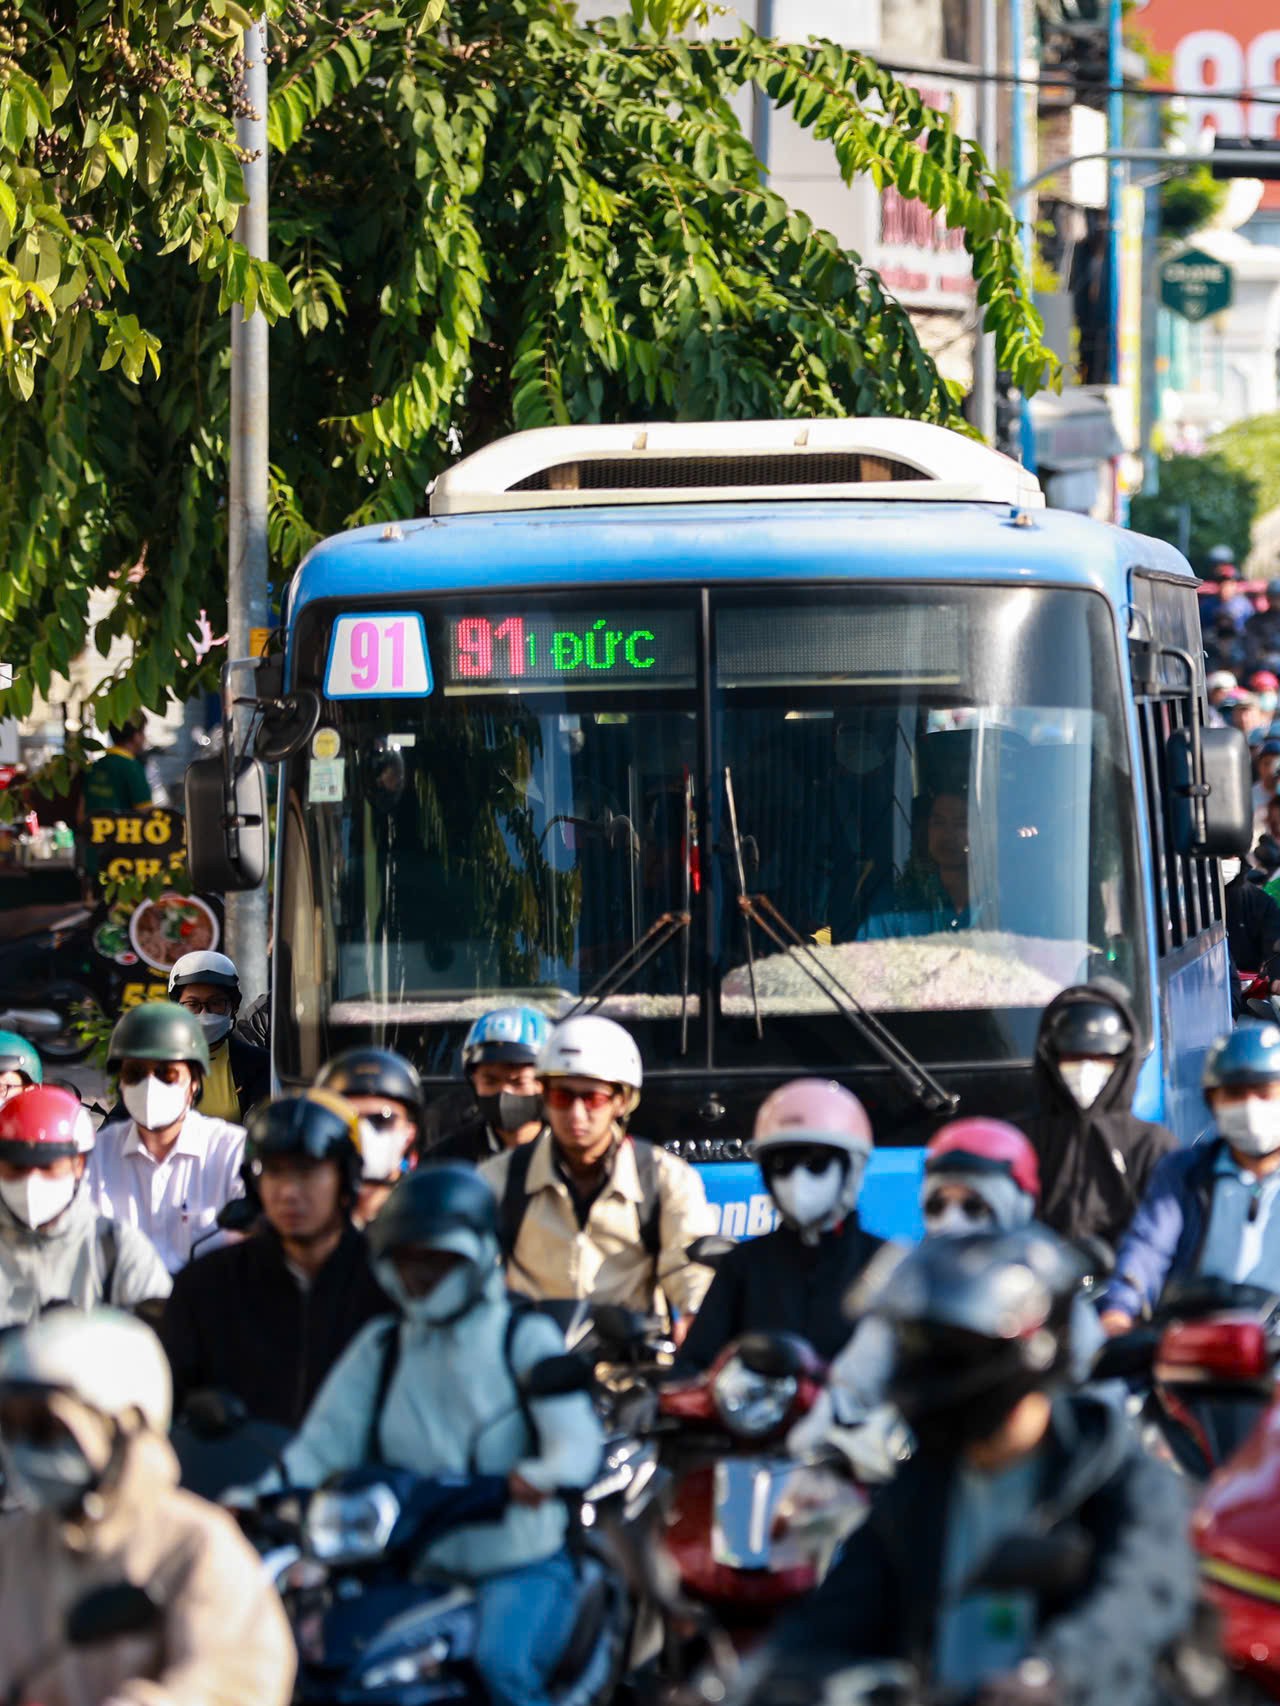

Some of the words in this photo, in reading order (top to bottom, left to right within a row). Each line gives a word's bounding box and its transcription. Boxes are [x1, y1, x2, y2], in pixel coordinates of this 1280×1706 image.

[350, 621, 405, 690] 91
[458, 617, 525, 676] 91
[550, 619, 655, 670] ĐỨC
[91, 809, 172, 845] PHỞ
